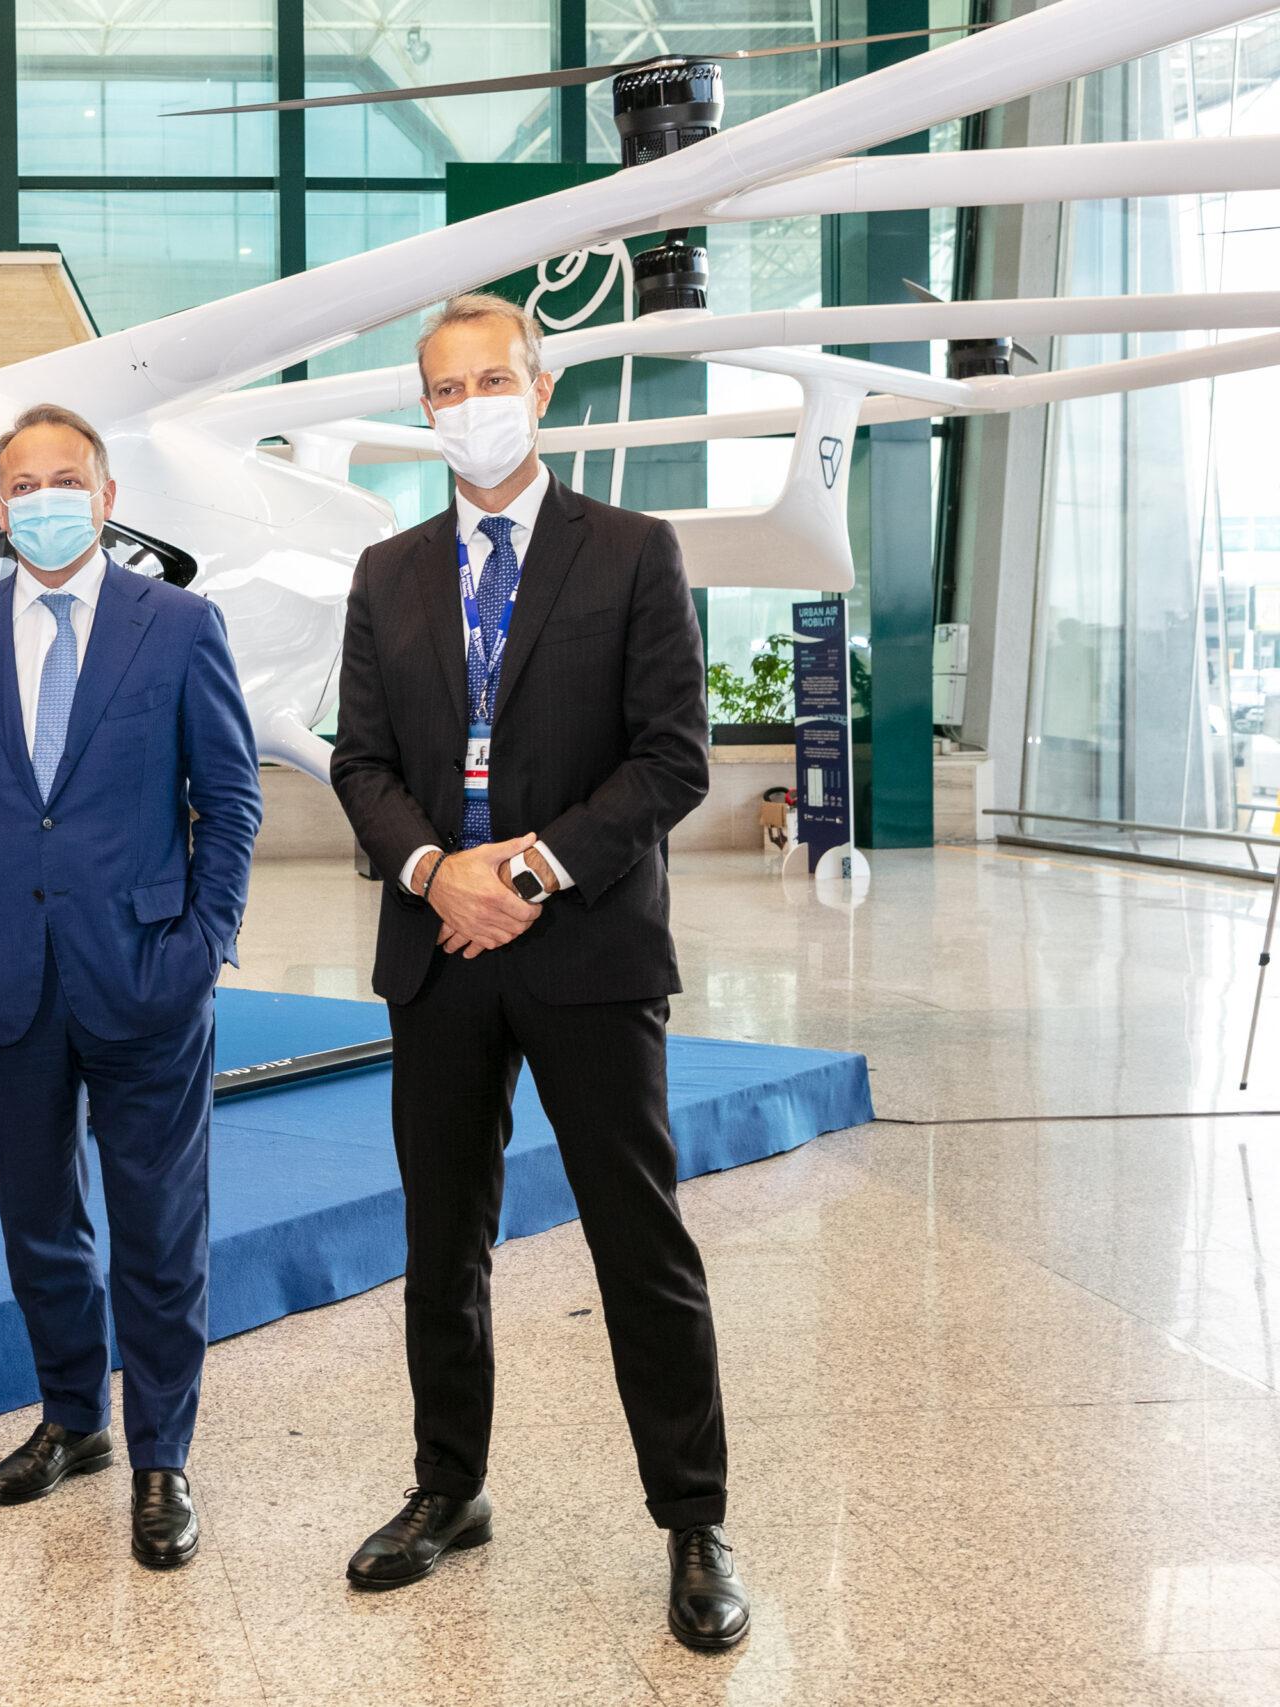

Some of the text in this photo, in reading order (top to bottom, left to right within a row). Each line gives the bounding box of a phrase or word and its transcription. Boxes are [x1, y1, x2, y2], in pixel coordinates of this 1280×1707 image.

[799, 606, 838, 618] URBAN AIR
[801, 617, 836, 627] MOBILITY
